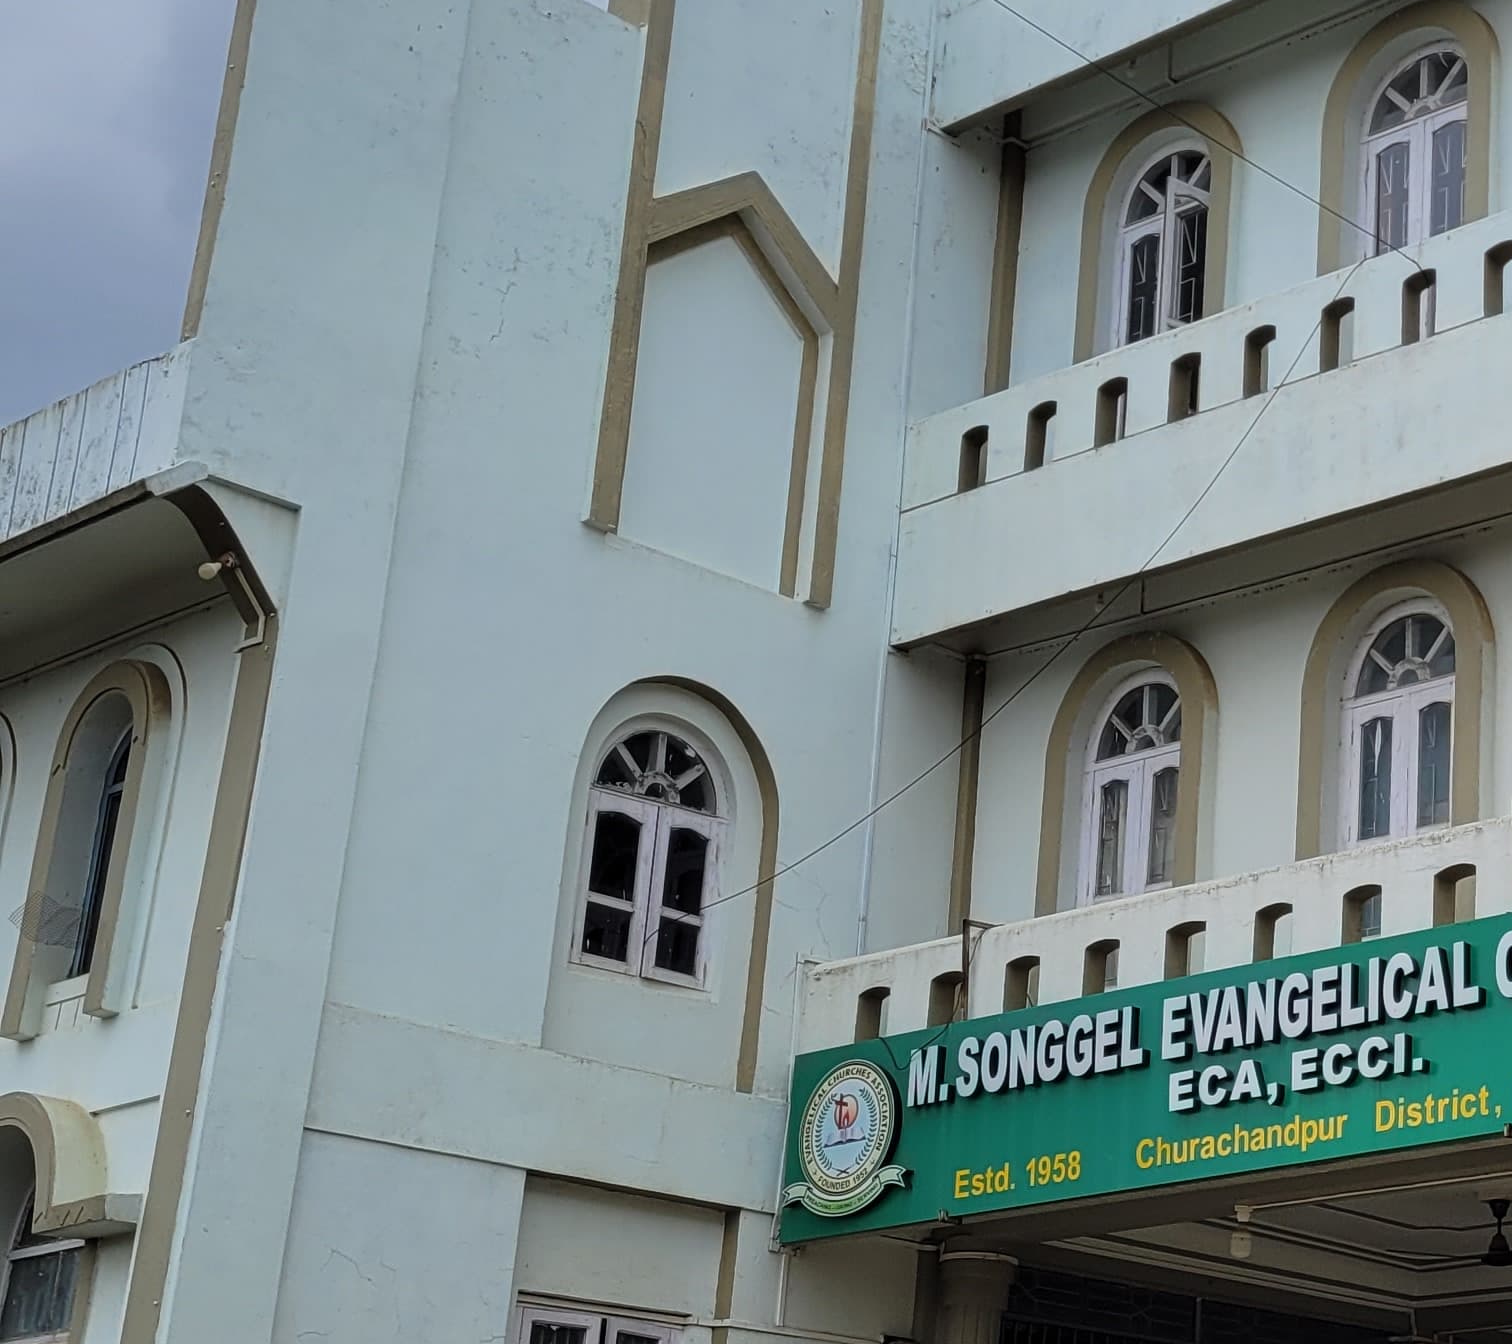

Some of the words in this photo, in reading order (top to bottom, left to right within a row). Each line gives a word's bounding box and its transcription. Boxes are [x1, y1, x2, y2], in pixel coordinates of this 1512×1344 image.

[1161, 941, 1481, 1061] EVANGELICAL
[1168, 1059, 1278, 1113] ECA,
[1291, 1032, 1424, 1092] ECCI.
[828, 1067, 872, 1087] CHURCHES
[870, 1077, 889, 1152] ASSOCIATION
[1135, 1114, 1348, 1170] Churachandpur
[817, 1175, 851, 1191] FOUNDED
[953, 1161, 1016, 1199] Estd.
[1025, 1150, 1082, 1187] 1958
